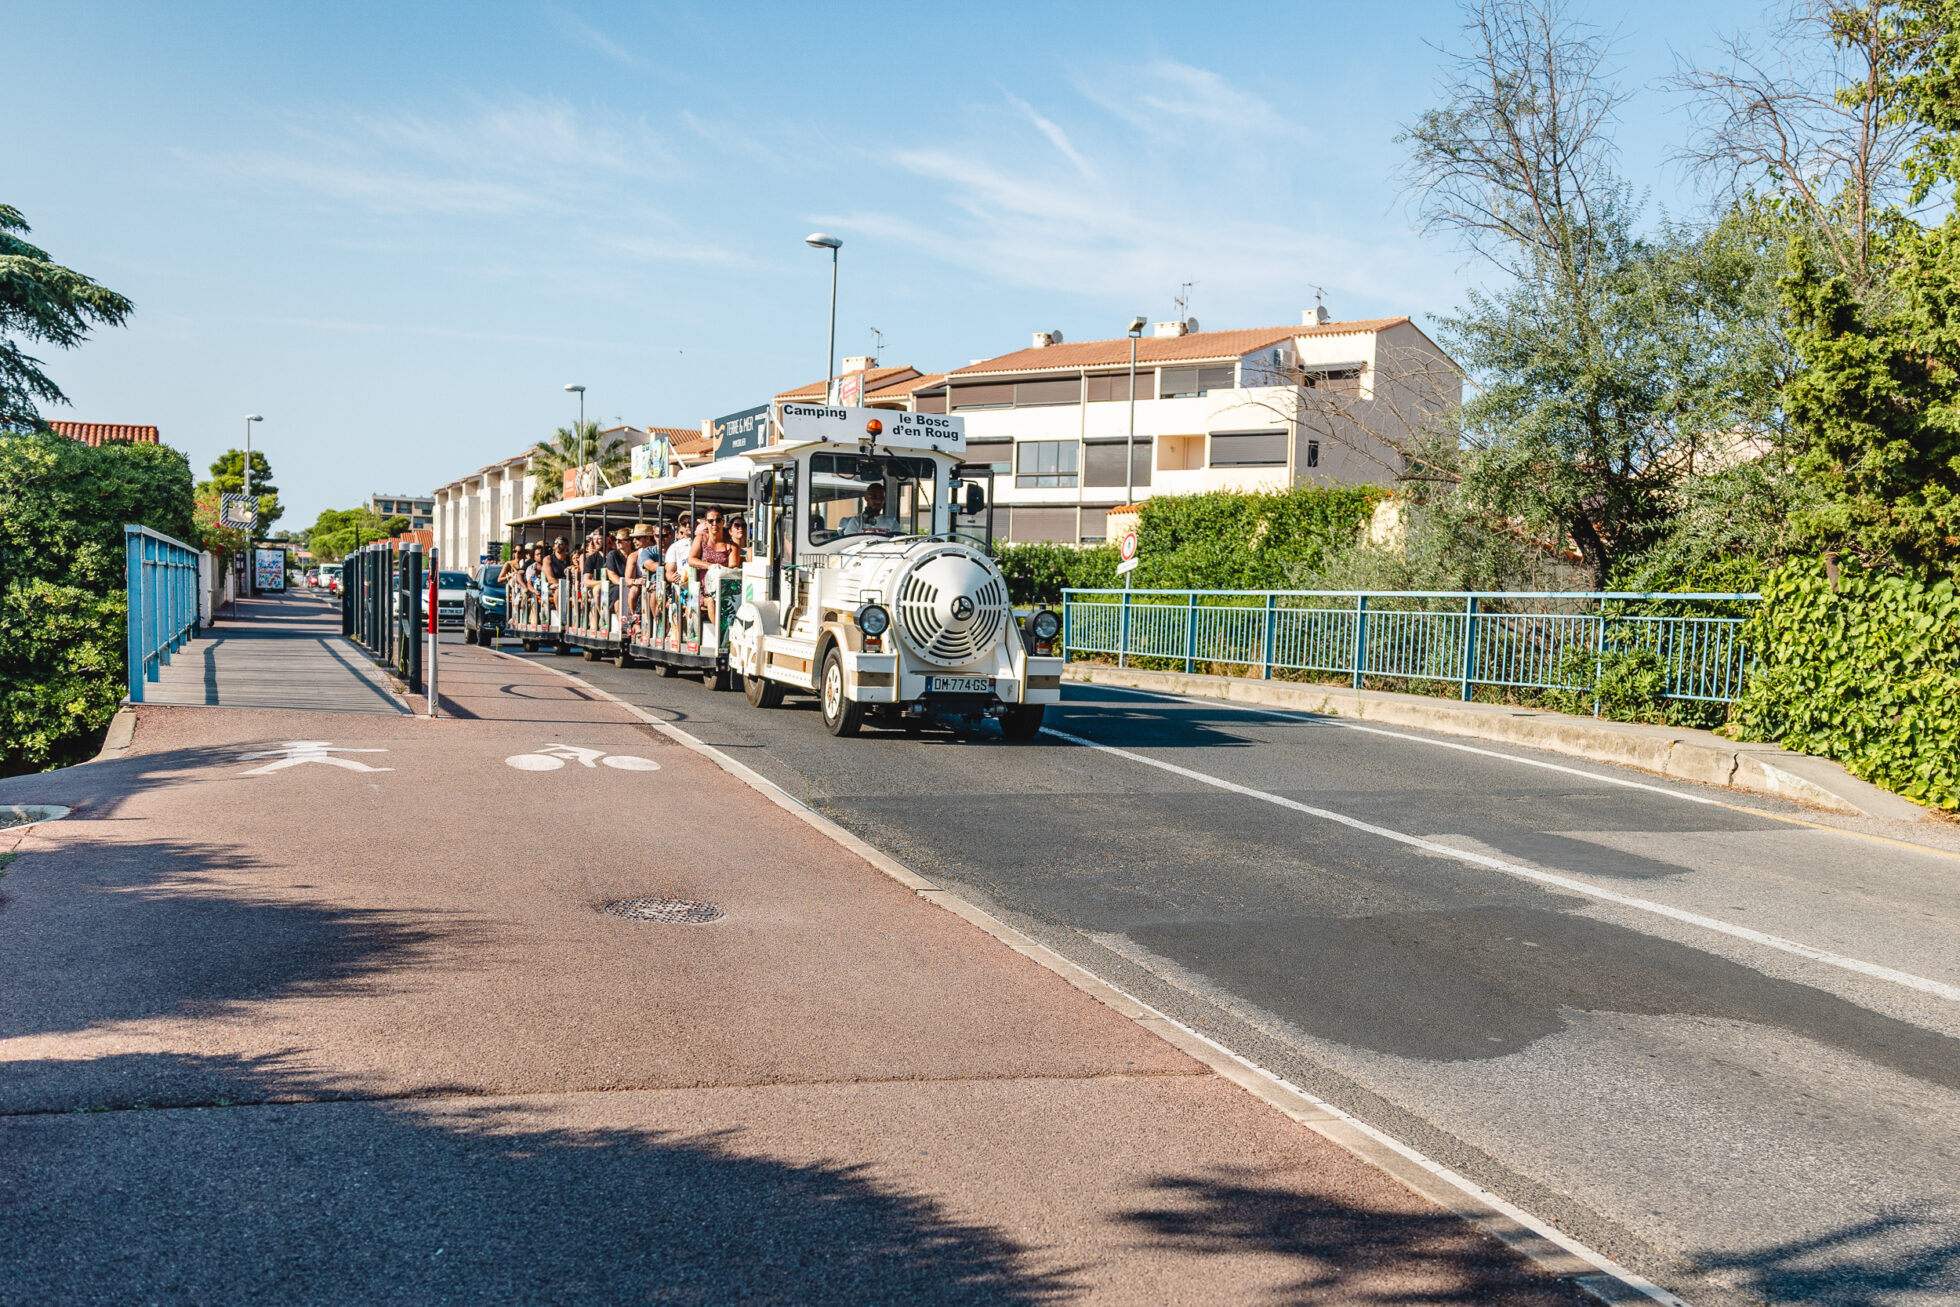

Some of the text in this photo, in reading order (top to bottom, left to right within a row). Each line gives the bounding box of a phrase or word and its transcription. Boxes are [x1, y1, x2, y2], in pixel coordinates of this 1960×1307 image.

[783, 404, 847, 420] Camping
[899, 413, 950, 427] le Bosc
[743, 416, 754, 432] MER
[892, 425, 959, 441] d'en Roug
[934, 678, 988, 691] DM-774-GS
